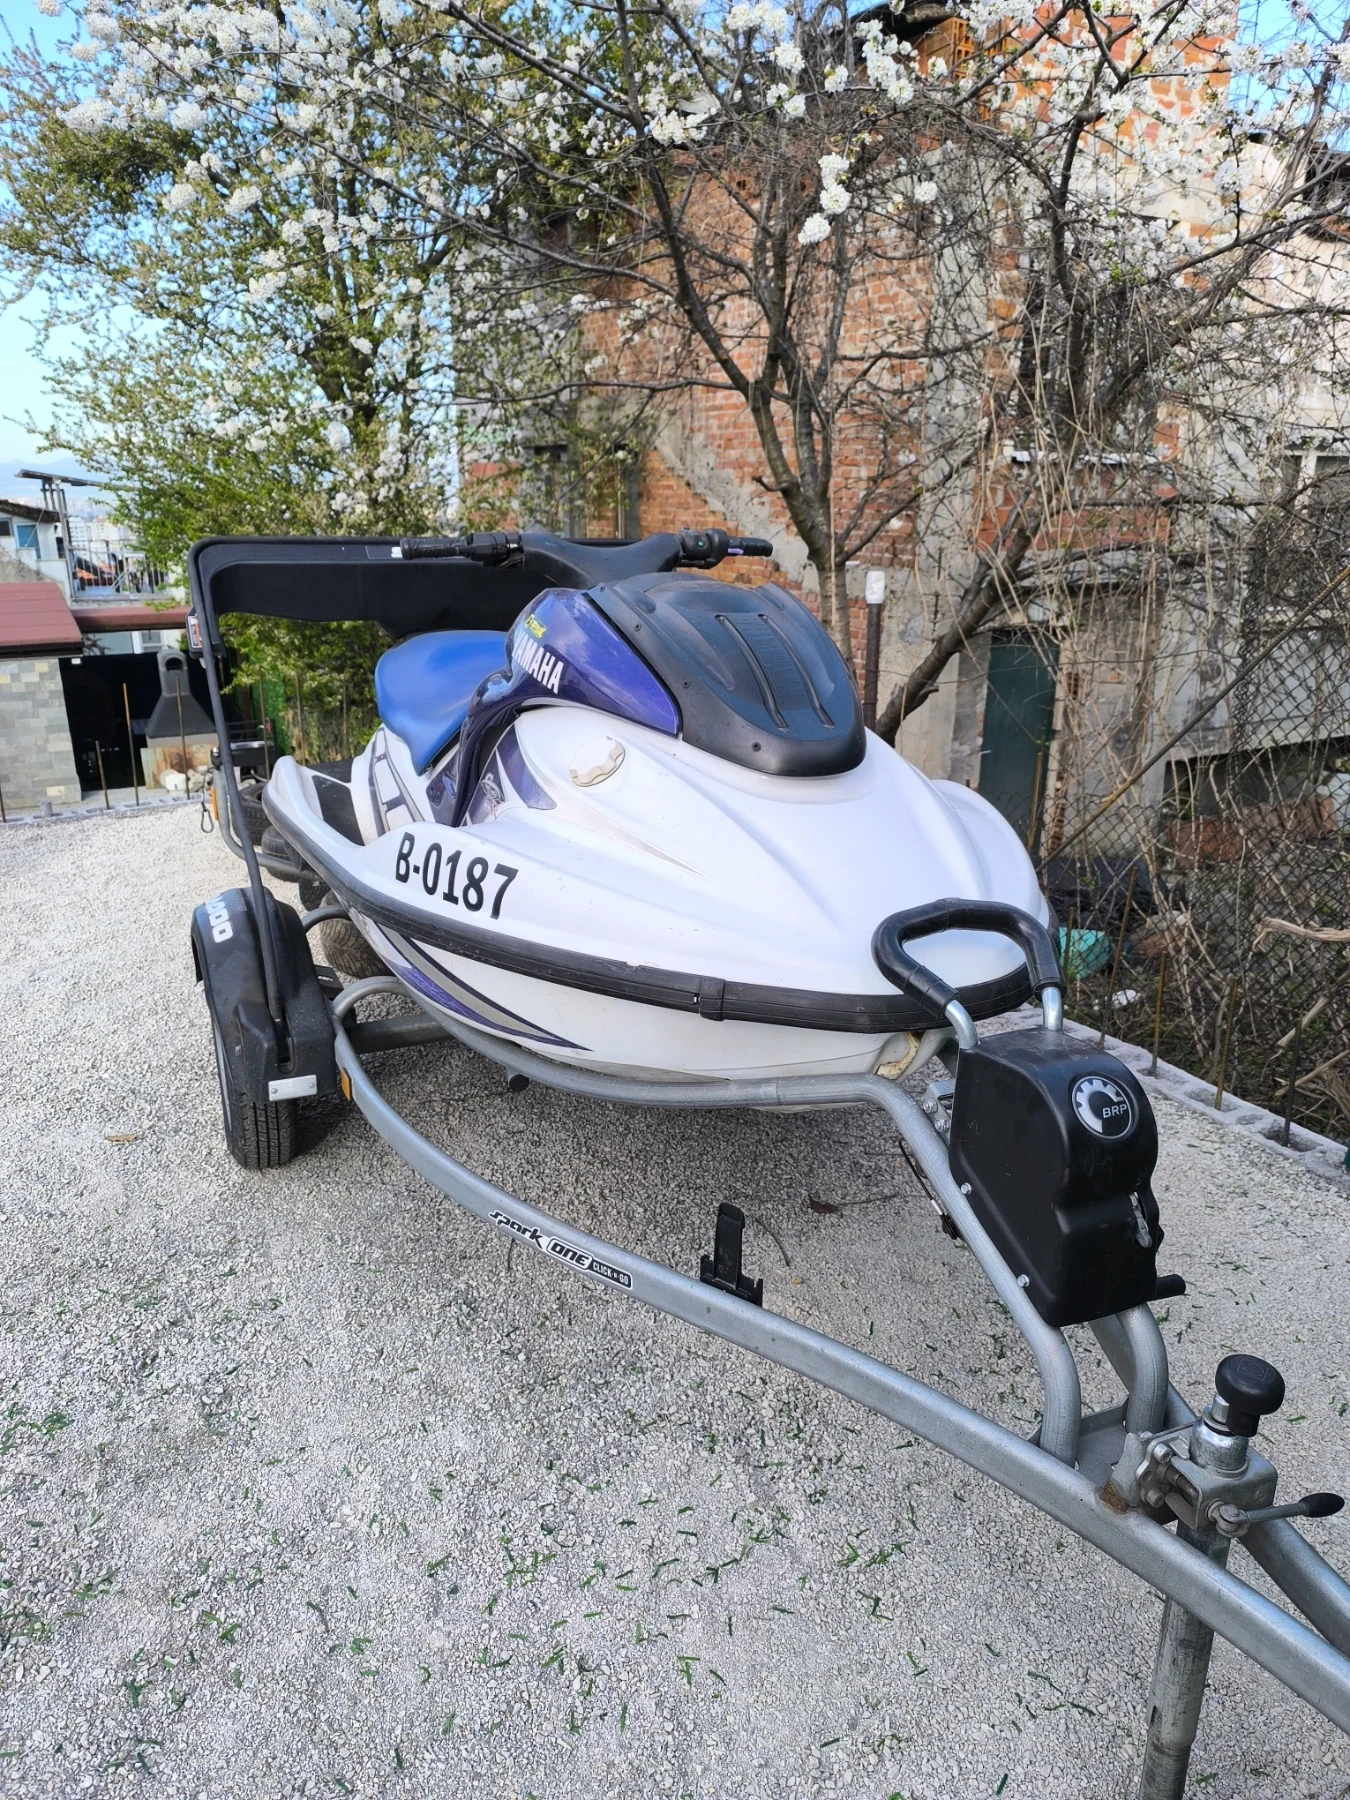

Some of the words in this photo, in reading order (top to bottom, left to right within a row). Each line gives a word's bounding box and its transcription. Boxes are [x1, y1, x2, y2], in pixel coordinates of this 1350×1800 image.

[512, 628, 564, 695] YAMAHA
[395, 831, 519, 920] B-0187
[1102, 1104, 1128, 1119] BRP
